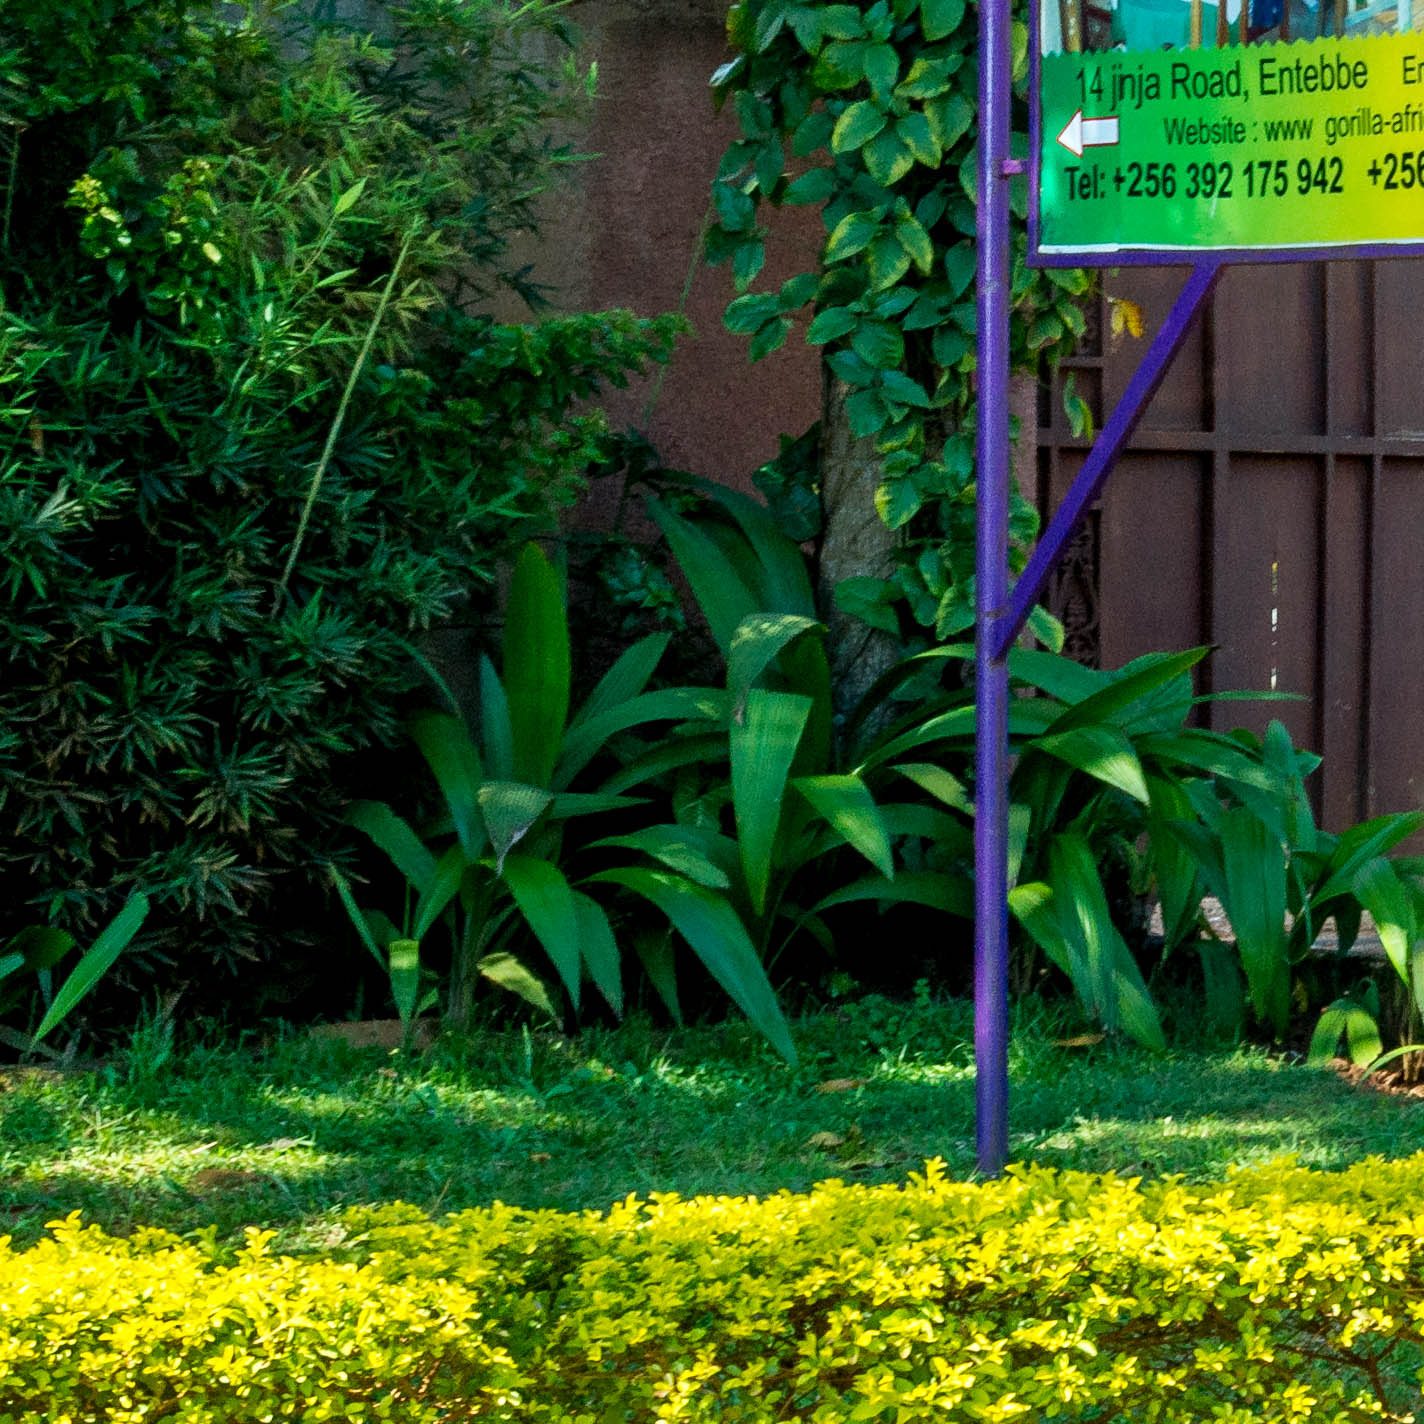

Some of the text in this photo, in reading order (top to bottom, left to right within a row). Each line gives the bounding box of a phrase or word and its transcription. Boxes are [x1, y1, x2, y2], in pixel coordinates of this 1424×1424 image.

[1076, 65, 1105, 104] 14
[1170, 60, 1250, 103] Road,
[1258, 52, 1369, 96] Entebbe
[1162, 115, 1247, 145] Website
[1063, 163, 1106, 201] Tel:
[1112, 160, 1177, 199] +256
[1185, 160, 1234, 199] 392
[1242, 159, 1289, 198] 175
[1296, 155, 1345, 195] 942
